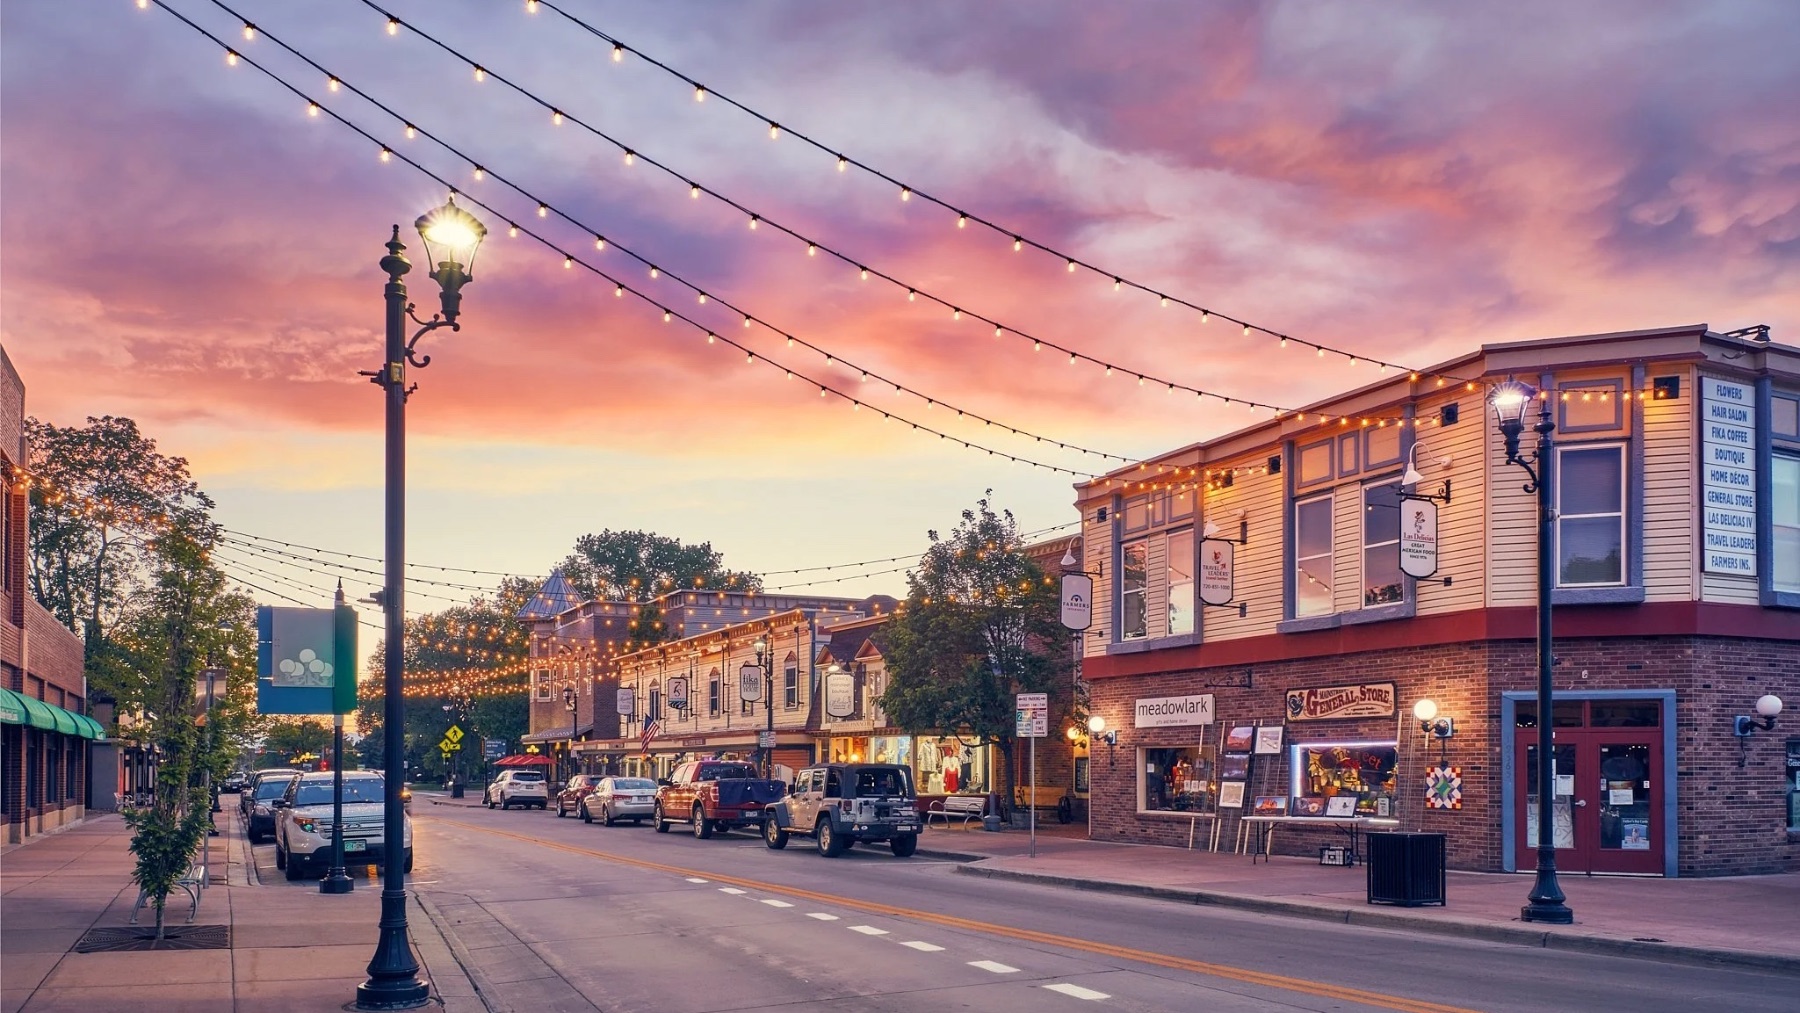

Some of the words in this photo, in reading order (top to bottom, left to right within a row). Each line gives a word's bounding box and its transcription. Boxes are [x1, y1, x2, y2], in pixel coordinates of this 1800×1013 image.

[1716, 384, 1742, 400] FLOWERS
[1711, 404, 1727, 419] HAIR
[1728, 408, 1748, 422] SALON
[1711, 426, 1726, 440] FIKA
[1727, 429, 1748, 443] COFFEE
[1714, 448, 1745, 465] BOUTIQUE
[1710, 469, 1728, 483] HOME
[1729, 470, 1750, 487] DÉCOR
[1707, 490, 1734, 505] GENERAL
[1735, 494, 1753, 508] STORE
[1708, 511, 1719, 524] LAS
[1720, 513, 1745, 528] DELICIAS
[1746, 517, 1753, 528] IV
[1707, 533, 1729, 547] TRAVEL
[1730, 536, 1755, 550] LEADERS
[1711, 555, 1738, 569] FARMERS
[1739, 558, 1751, 571] INS.
[1062, 601, 1090, 609] FARMERS
[1138, 697, 1208, 716] meadowlark
[1306, 689, 1357, 716] GENERAL
[1359, 684, 1390, 704] STORE
